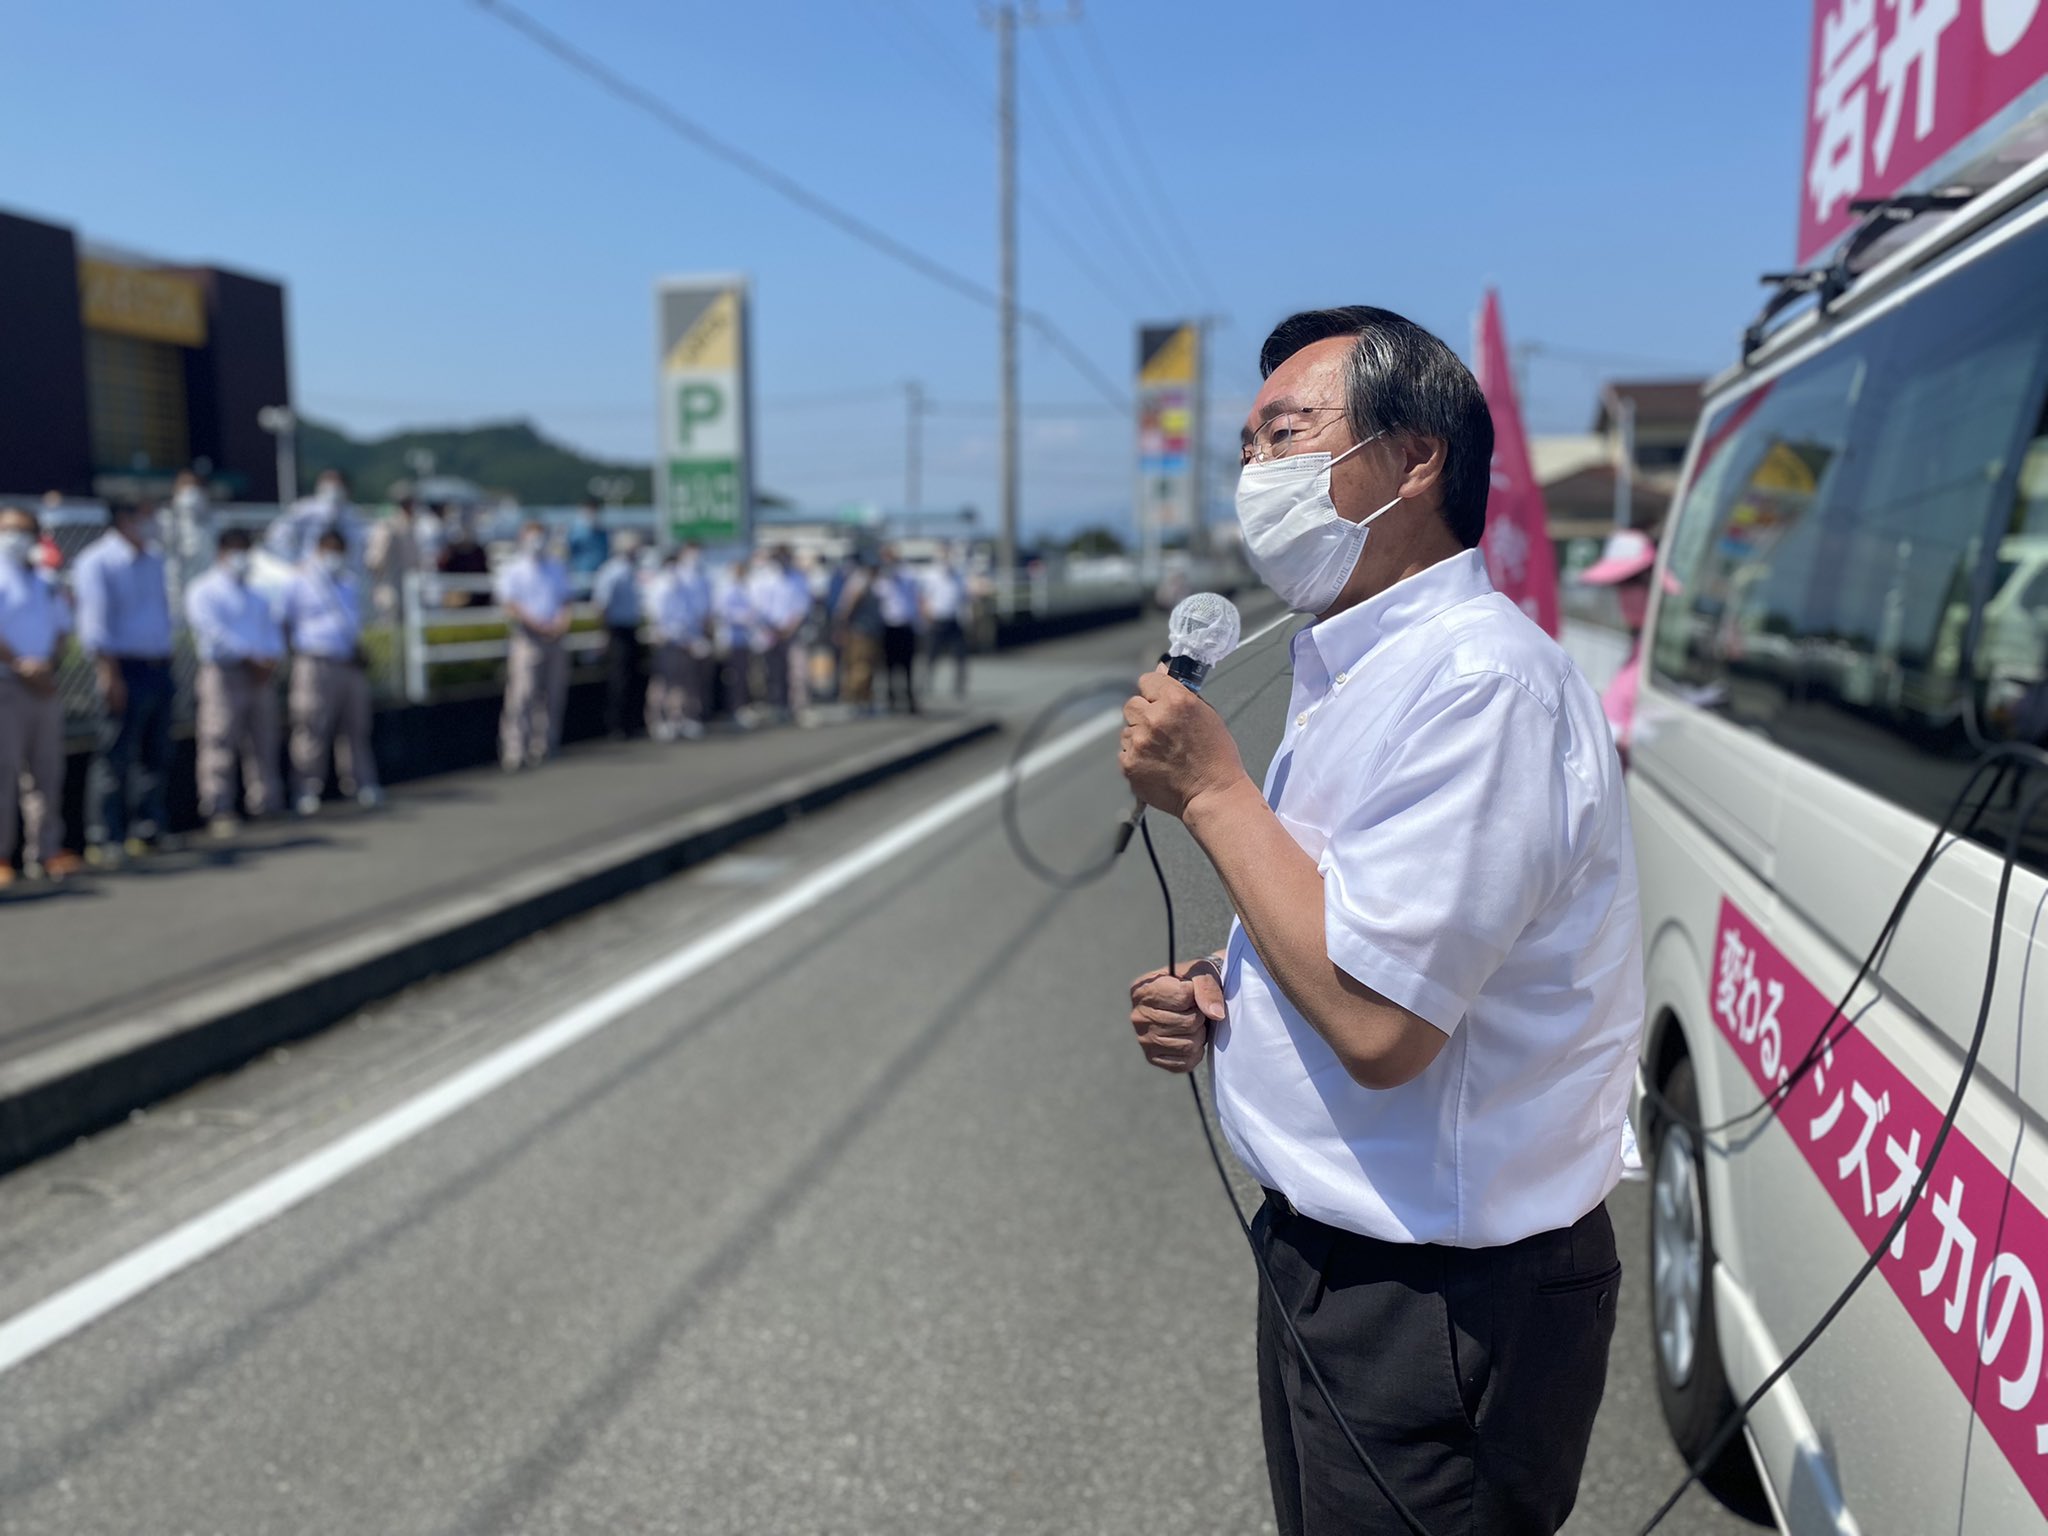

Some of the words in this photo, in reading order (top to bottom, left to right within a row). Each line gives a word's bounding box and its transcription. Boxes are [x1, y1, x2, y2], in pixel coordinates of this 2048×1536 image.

[677, 380, 724, 447] P
[1716, 929, 2048, 1455] 変わる。シズオカの
